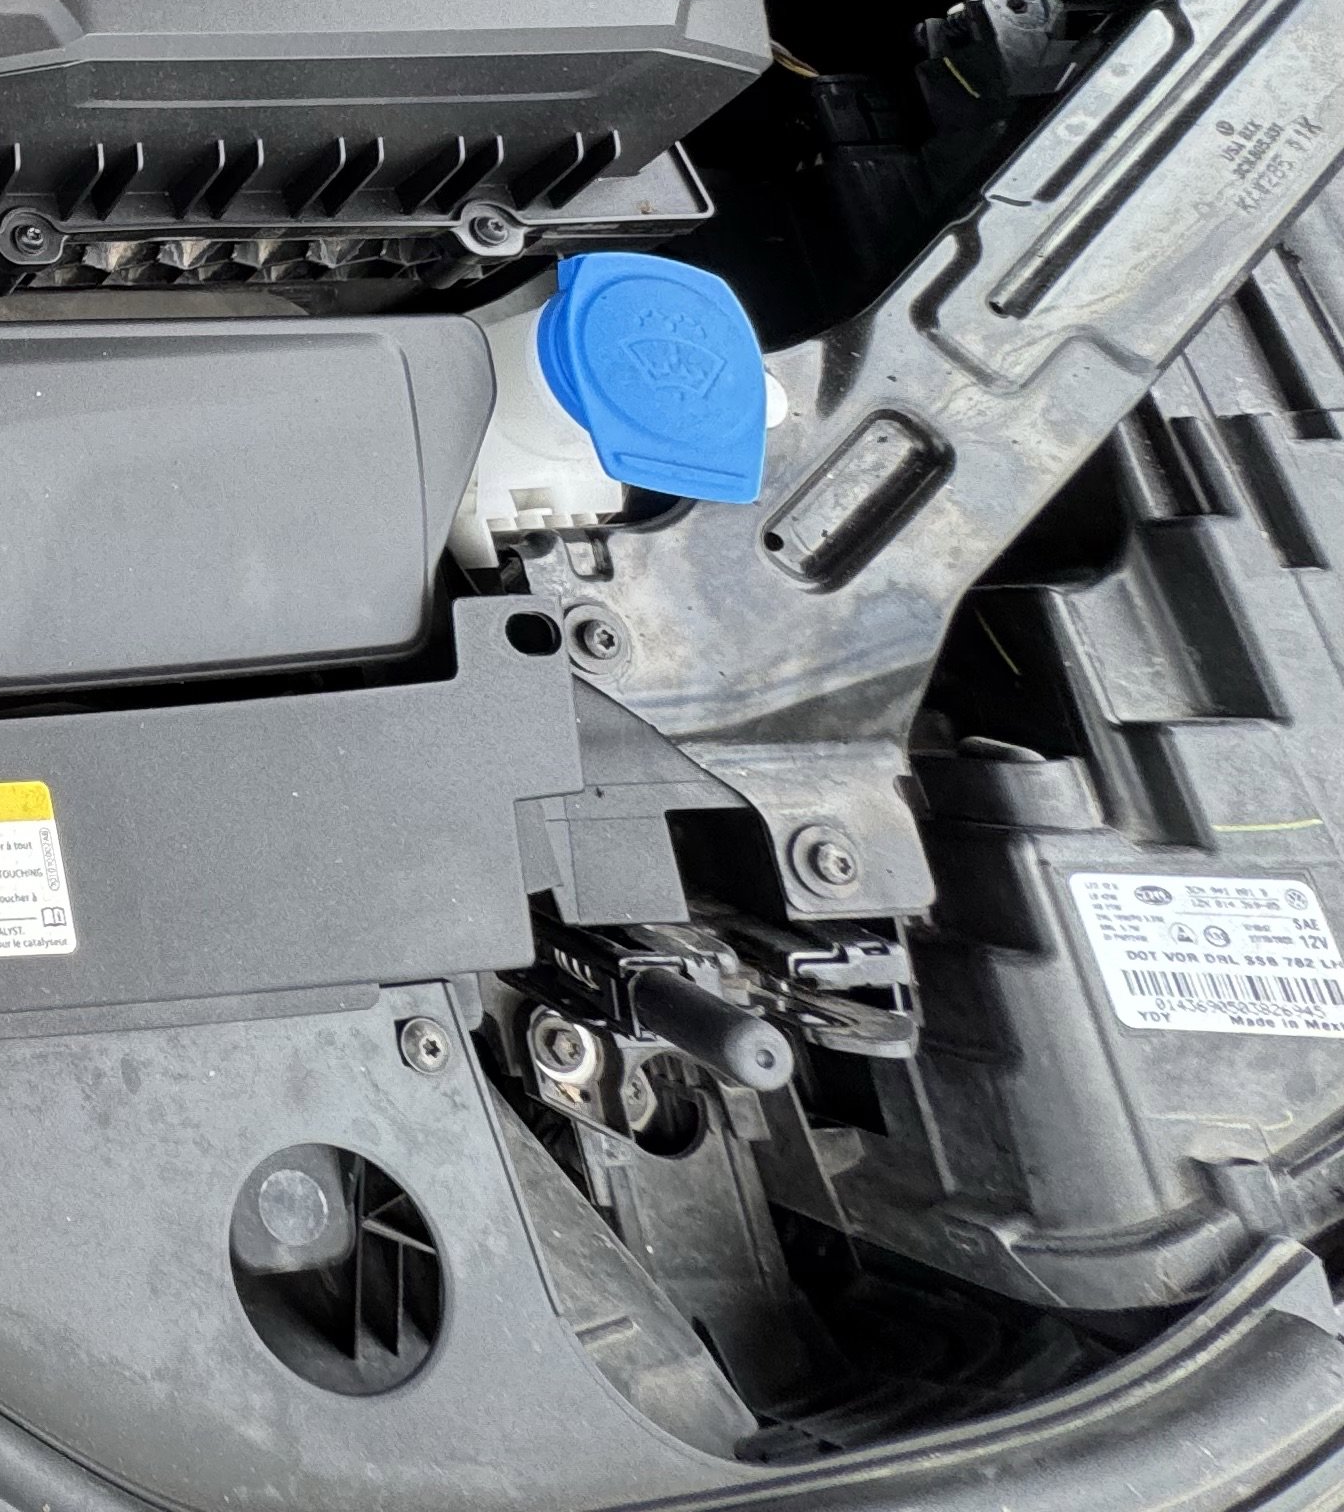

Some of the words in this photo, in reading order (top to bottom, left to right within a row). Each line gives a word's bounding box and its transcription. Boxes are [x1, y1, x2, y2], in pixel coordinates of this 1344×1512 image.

[14, 842, 33, 850] tout
[1292, 918, 1320, 931] SAE
[1299, 935, 1329, 950] 12V
[1126, 951, 1158, 962] DOT
[1165, 952, 1199, 963] VOR
[1204, 954, 1239, 966] DRL
[1283, 957, 1315, 969] 782
[1229, 1015, 1275, 1029] Made
[1281, 1018, 1299, 1029] in
[1304, 1019, 1344, 1033] Mexi
